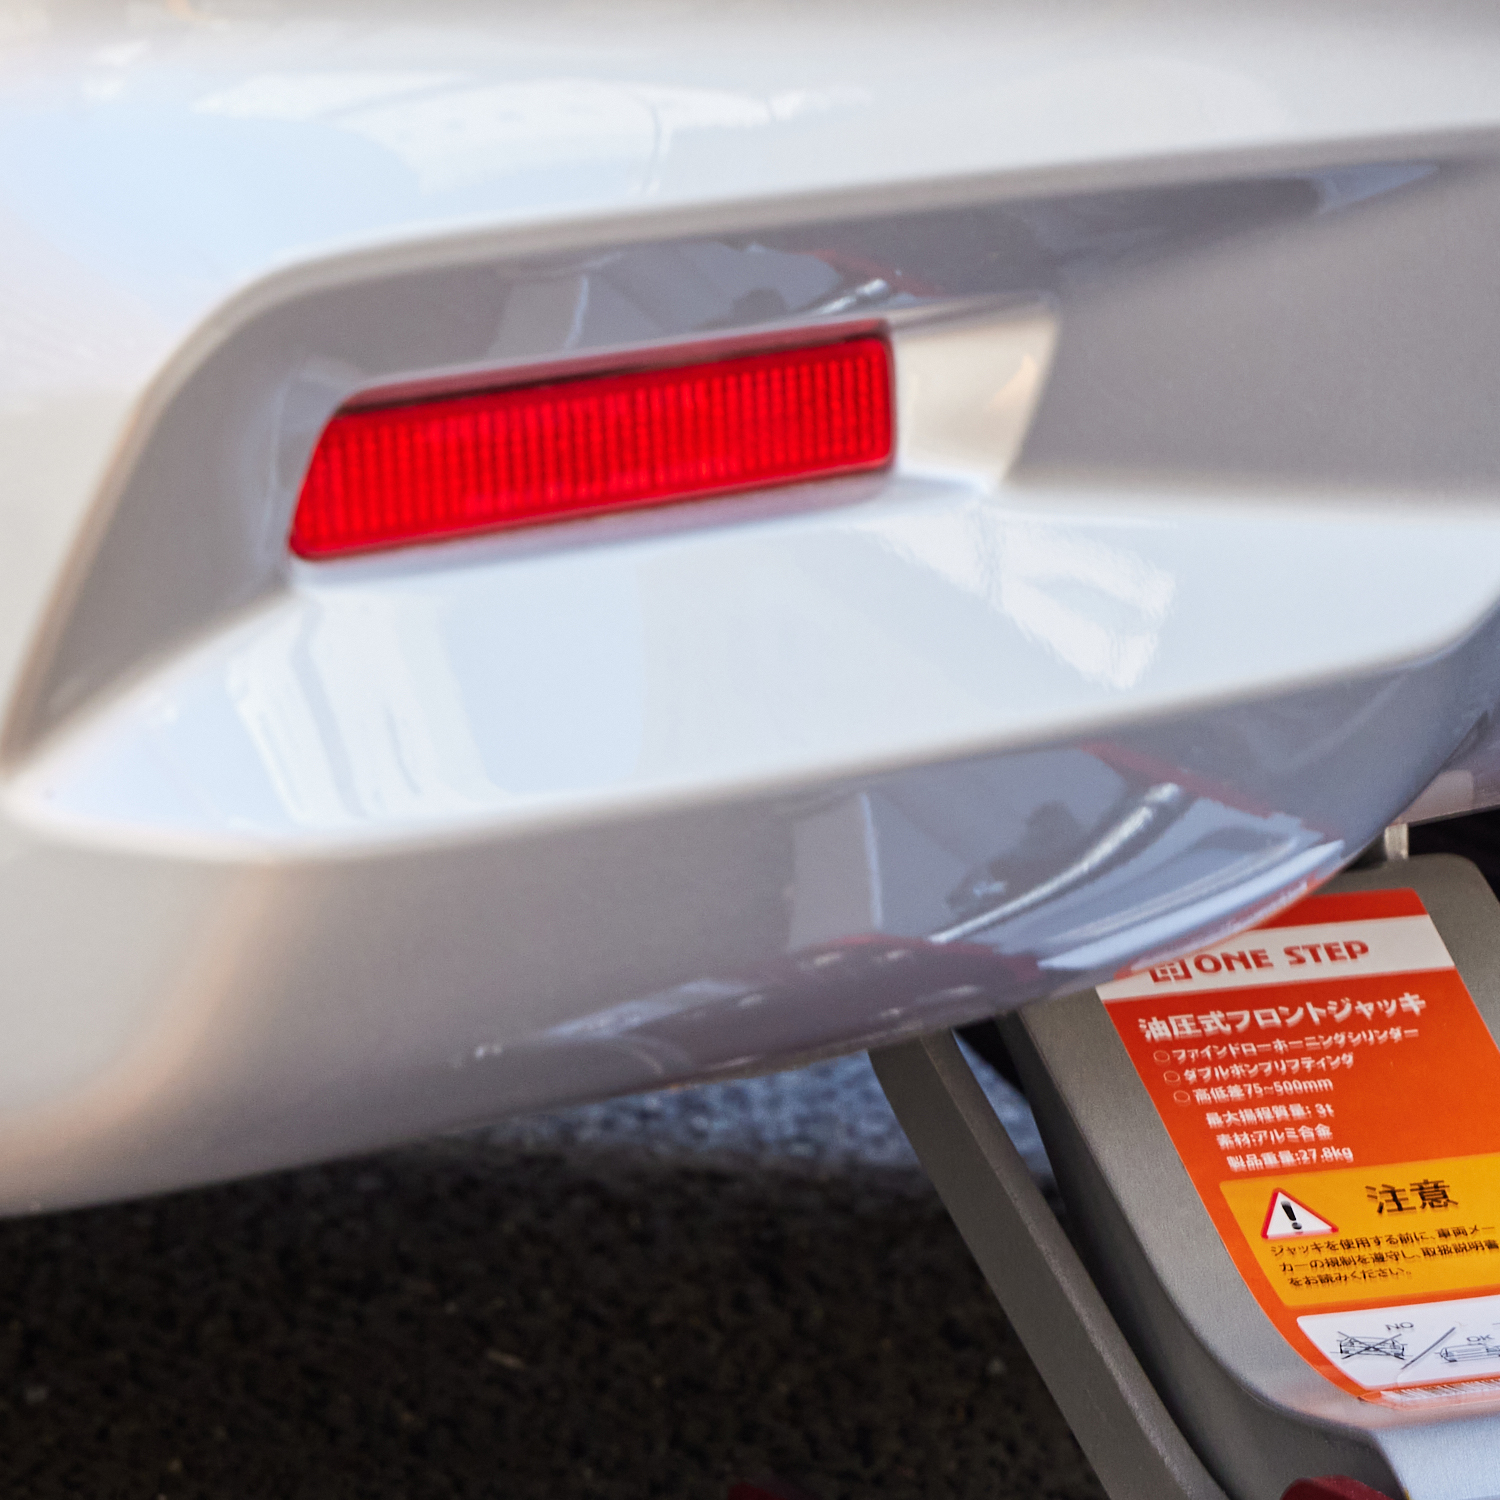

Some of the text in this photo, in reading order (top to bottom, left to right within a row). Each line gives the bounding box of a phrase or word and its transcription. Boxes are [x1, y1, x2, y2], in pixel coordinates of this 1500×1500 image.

[1194, 940, 1369, 975] ONE STEP
[1138, 992, 1426, 1042] 油圧式フロントジャッキ
[1365, 1179, 1459, 1214] 注意
[1385, 1321, 1414, 1332] NO
